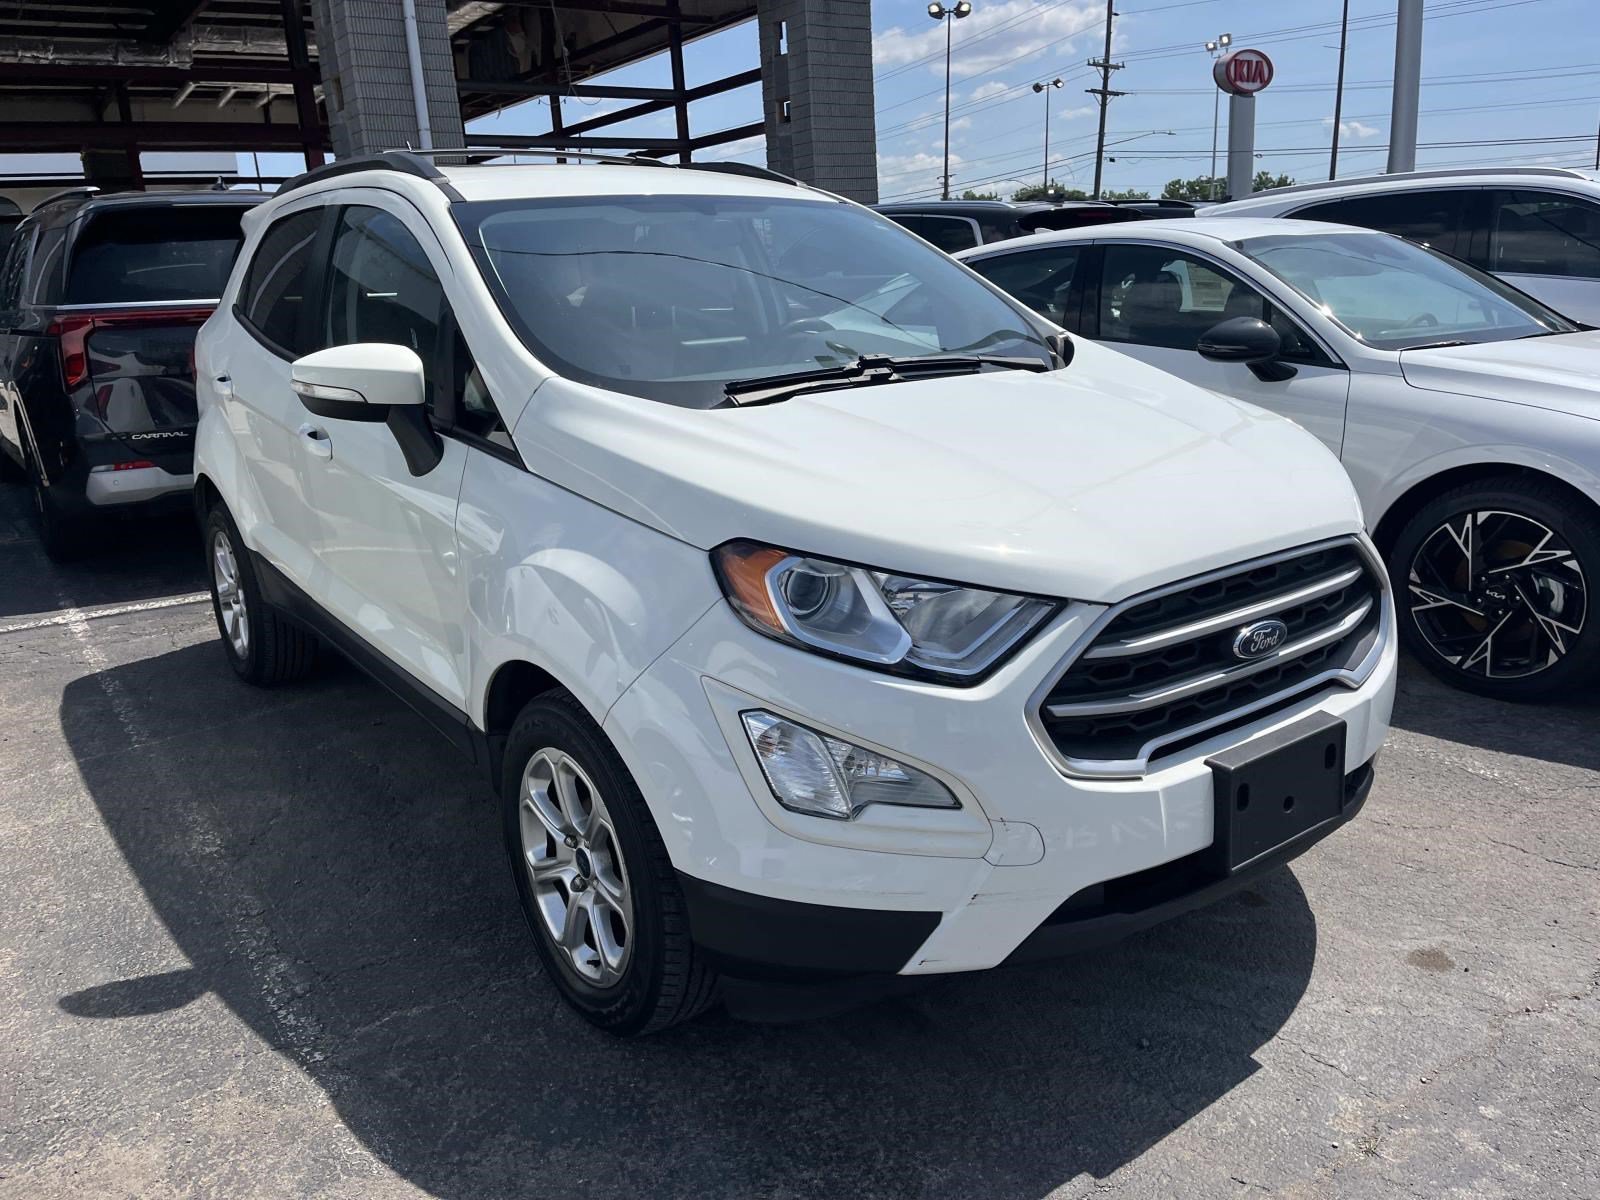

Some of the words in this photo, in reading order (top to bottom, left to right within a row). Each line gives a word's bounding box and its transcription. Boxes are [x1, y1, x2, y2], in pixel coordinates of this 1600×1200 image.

[1234, 59, 1265, 83] KIA
[132, 431, 189, 440] CARNIVAL
[1251, 628, 1279, 652] Ford
